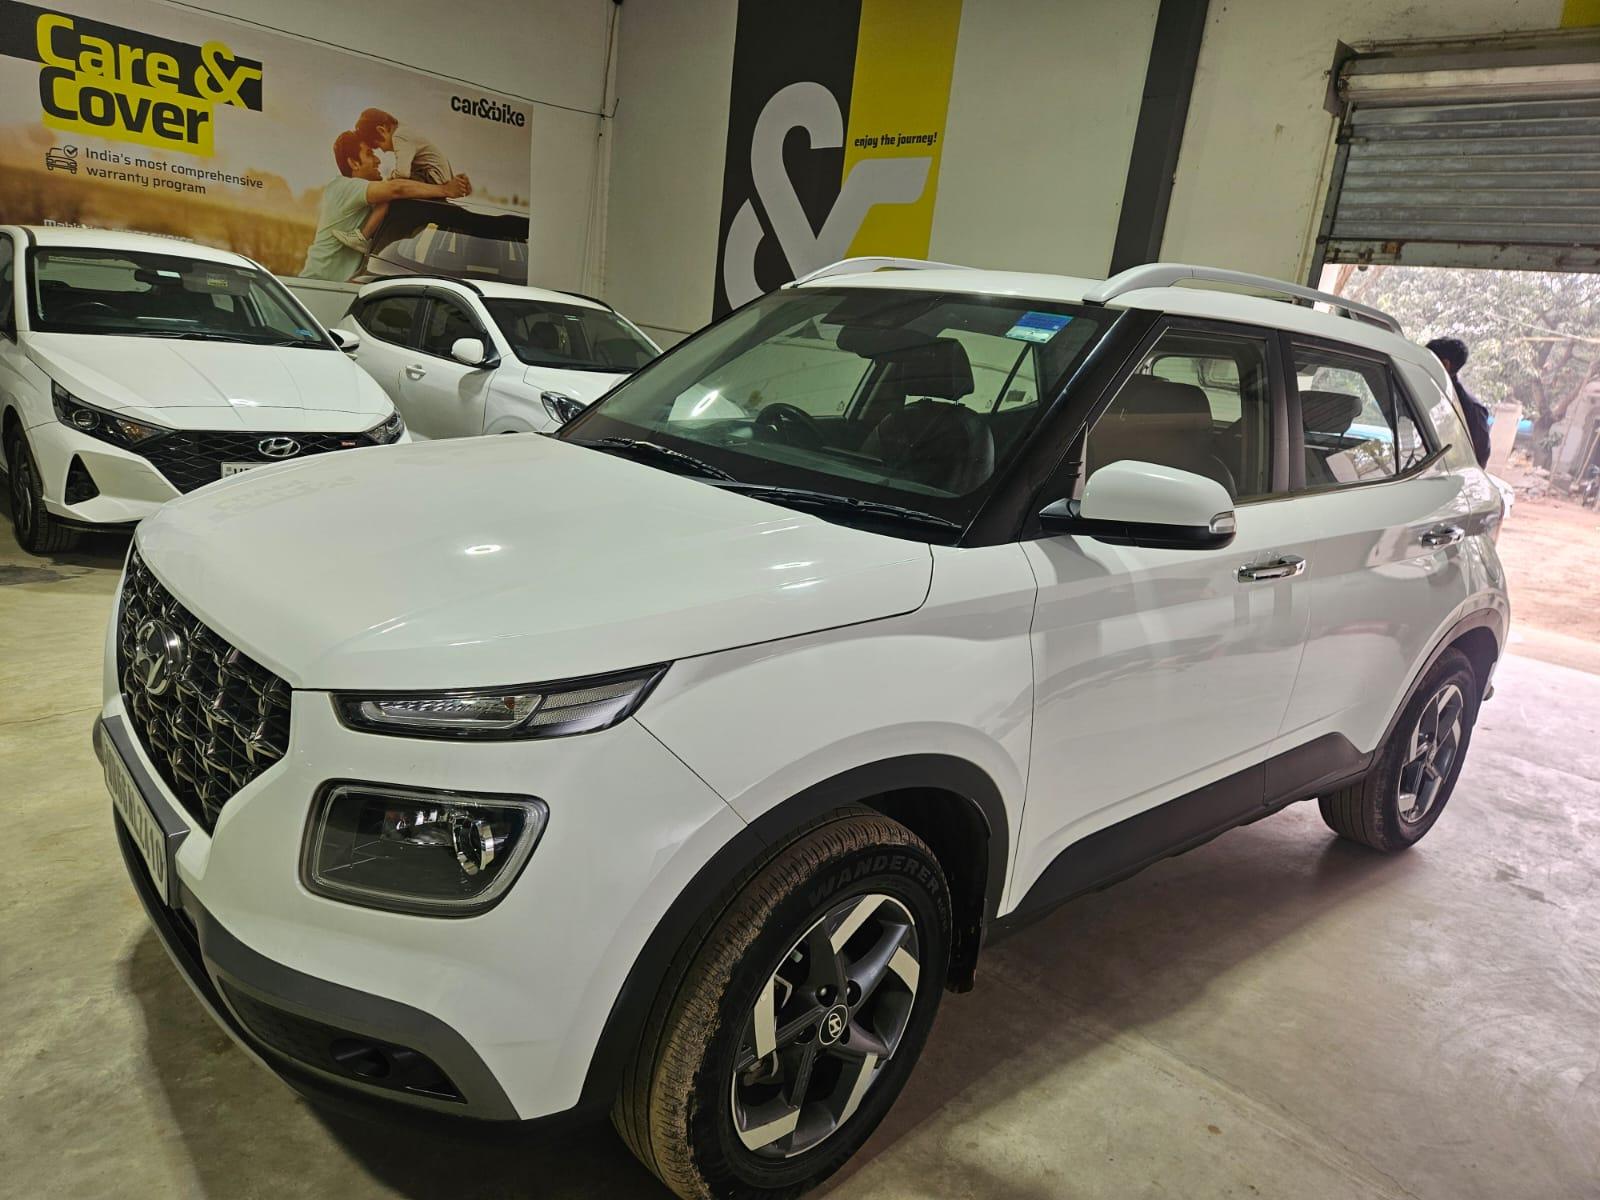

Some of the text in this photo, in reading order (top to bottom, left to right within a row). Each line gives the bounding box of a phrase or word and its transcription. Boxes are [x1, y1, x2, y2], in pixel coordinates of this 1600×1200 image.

[37, 13, 262, 110] Care &
[39, 67, 209, 145] Cover
[451, 95, 525, 127] car&bike
[854, 131, 938, 149] enjoy the journey!
[85, 147, 264, 189] India's most comprehensive
[86, 166, 207, 195] warranty program
[807, 854, 940, 910] WANDERER
